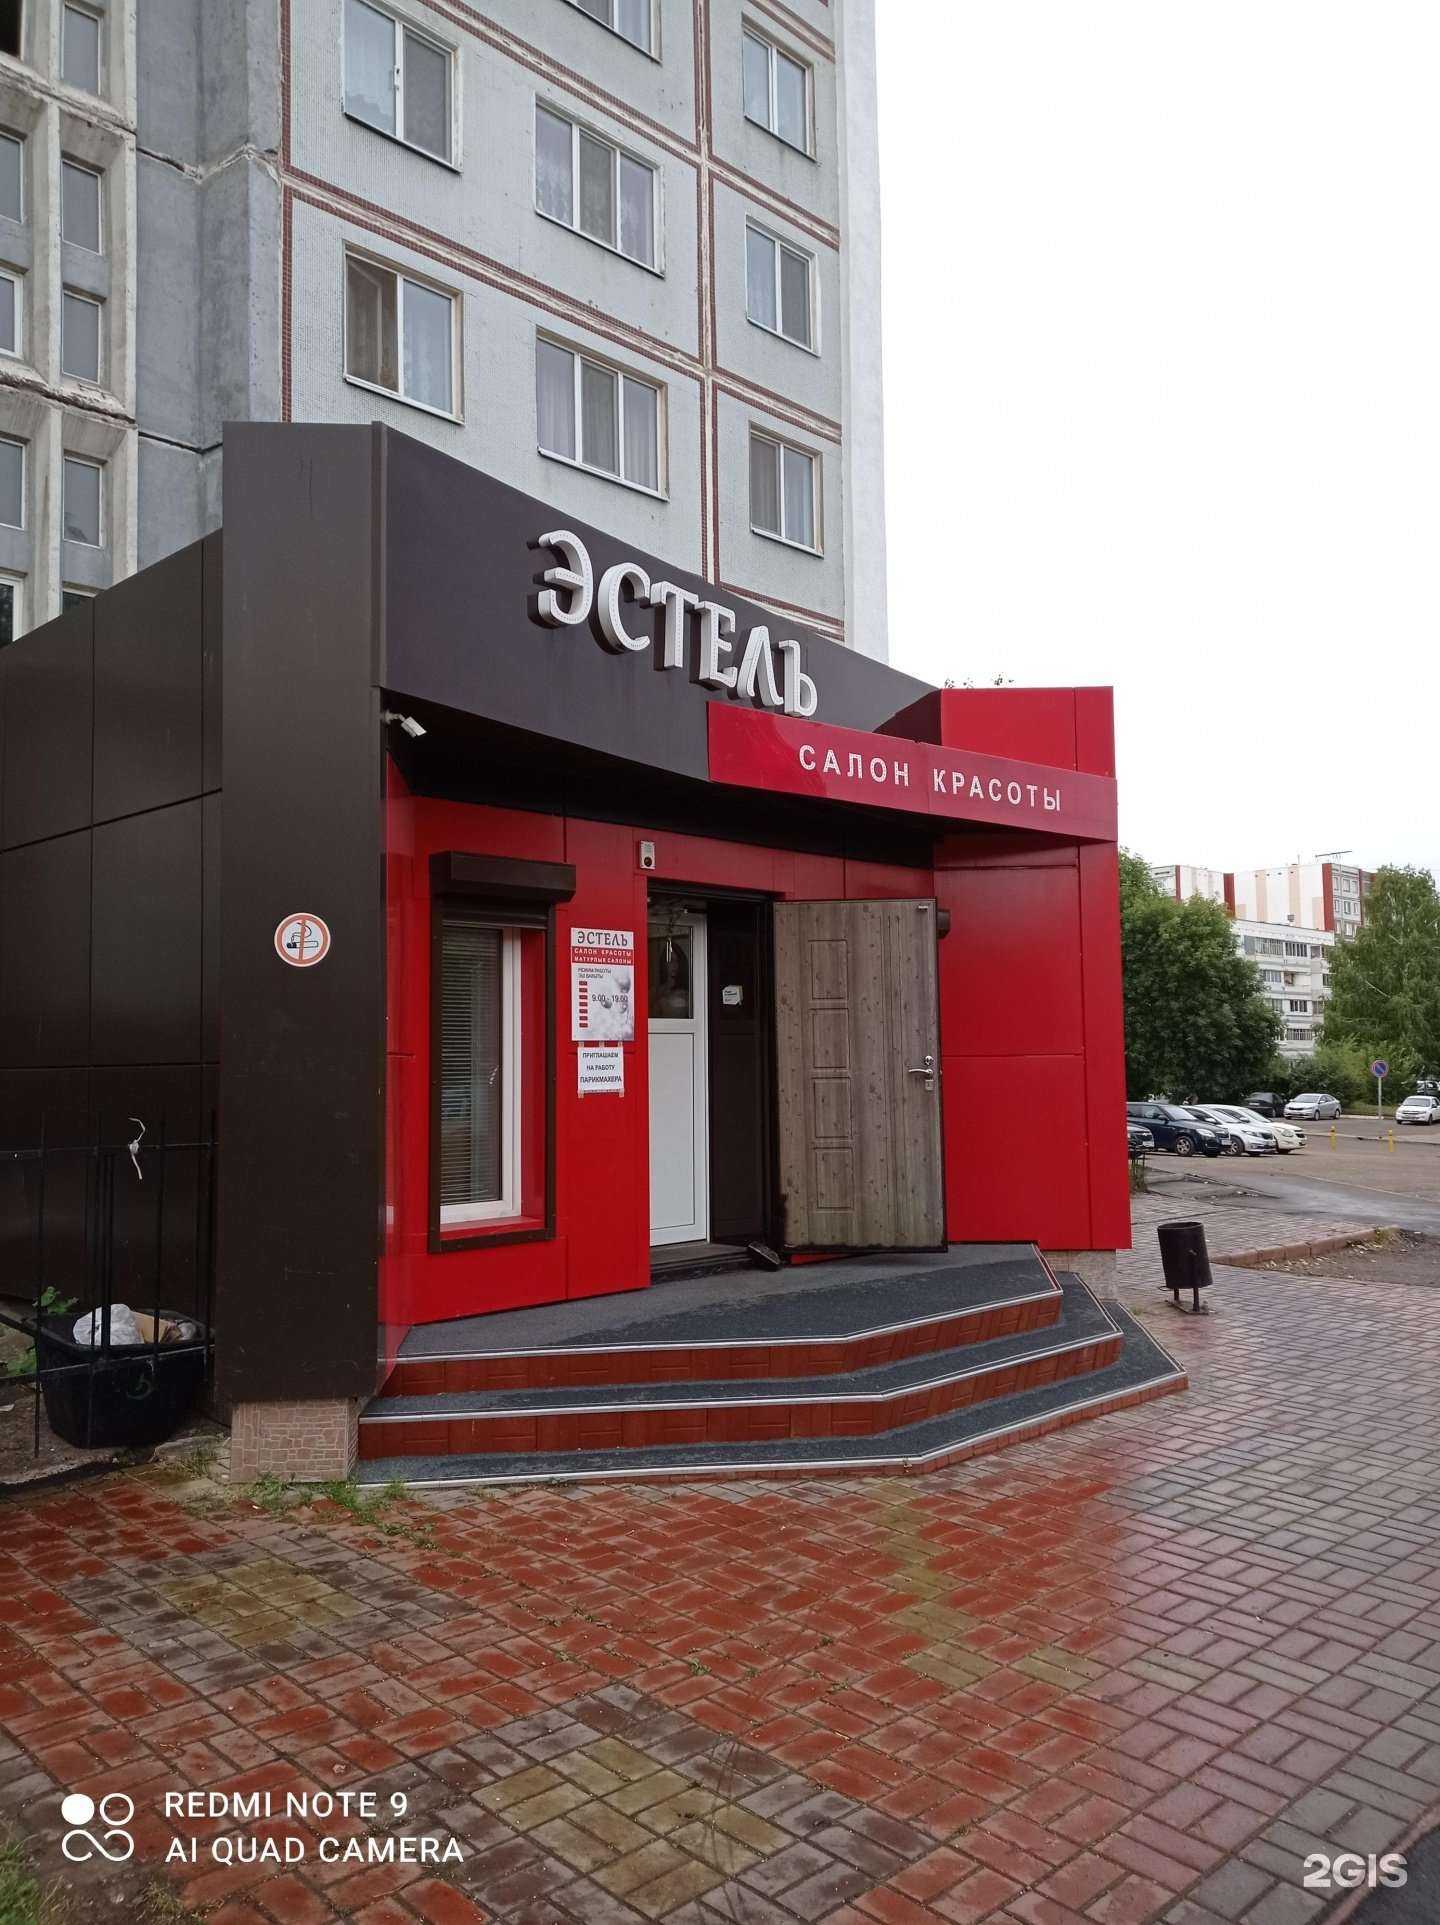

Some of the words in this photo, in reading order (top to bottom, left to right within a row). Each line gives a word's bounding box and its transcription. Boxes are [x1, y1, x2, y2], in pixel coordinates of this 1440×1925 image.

[534, 530, 818, 718] ЭСТЕЛЬ
[799, 744, 910, 787] САЛОН
[933, 768, 1061, 811] КРАСОТЫ
[577, 931, 628, 946] ЭСТЕЛЬ
[601, 949, 632, 957] КРАСОТЫ
[579, 1075, 622, 1083] ПАРИКМАХЕРА
